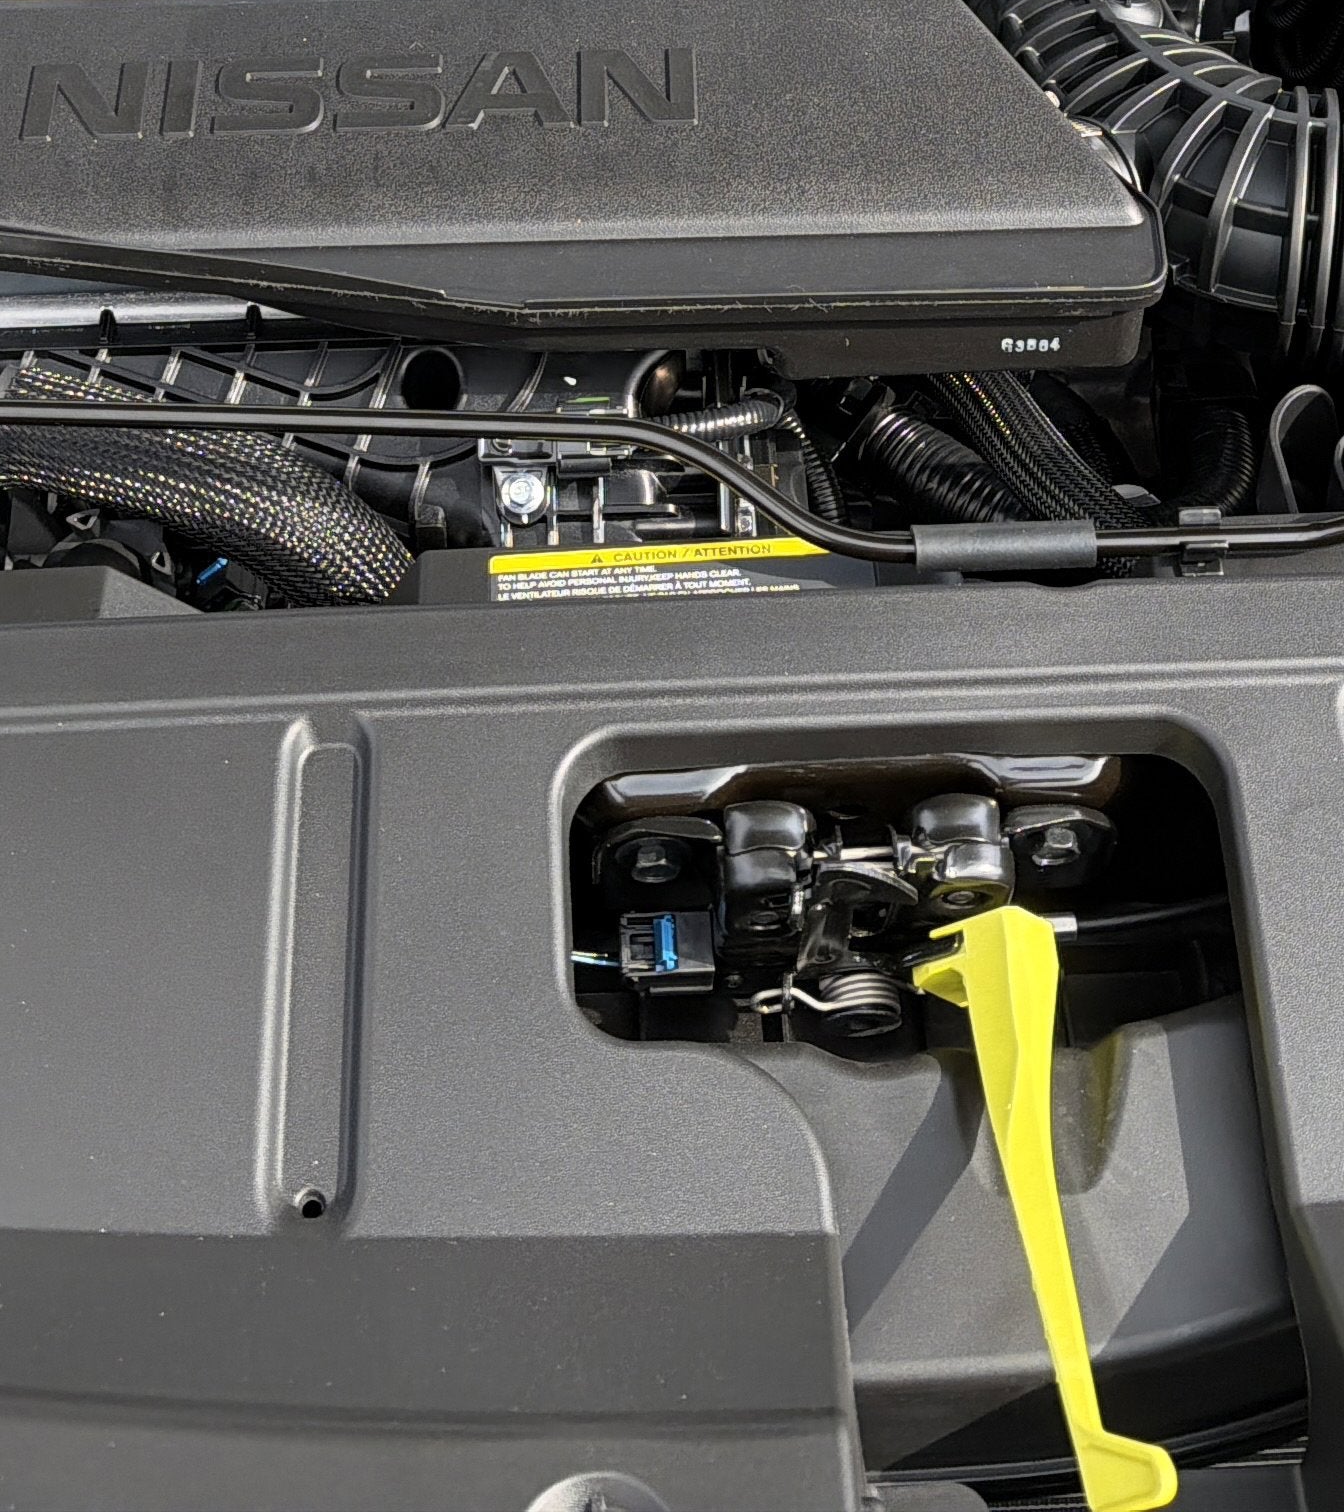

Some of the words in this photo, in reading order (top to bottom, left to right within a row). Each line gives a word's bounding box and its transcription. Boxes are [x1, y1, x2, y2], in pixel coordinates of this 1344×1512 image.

[19, 48, 698, 142] NISSAN
[613, 550, 677, 563] CAUTION
[693, 544, 772, 557] ATTENTION
[497, 574, 516, 582] FAN
[518, 572, 548, 581] BLADE
[549, 570, 570, 579] CAN
[571, 568, 599, 577] START
[600, 567, 612, 575] AT
[614, 567, 632, 575] ANY
[497, 583, 511, 591] TO
[513, 581, 537, 590] HELP
[538, 579, 567, 588] AVOID
[568, 576, 617, 586] PERSONAL
[675, 571, 708, 580] HANDS
[497, 593, 510, 602] LE
[511, 589, 571, 601] VENTILATEUR
[572, 586, 607, 596] RISQUE
[608, 586, 622, 594] DE
[623, 582, 674, 593] DÉMARRER
[684, 580, 708, 589] TOUT
